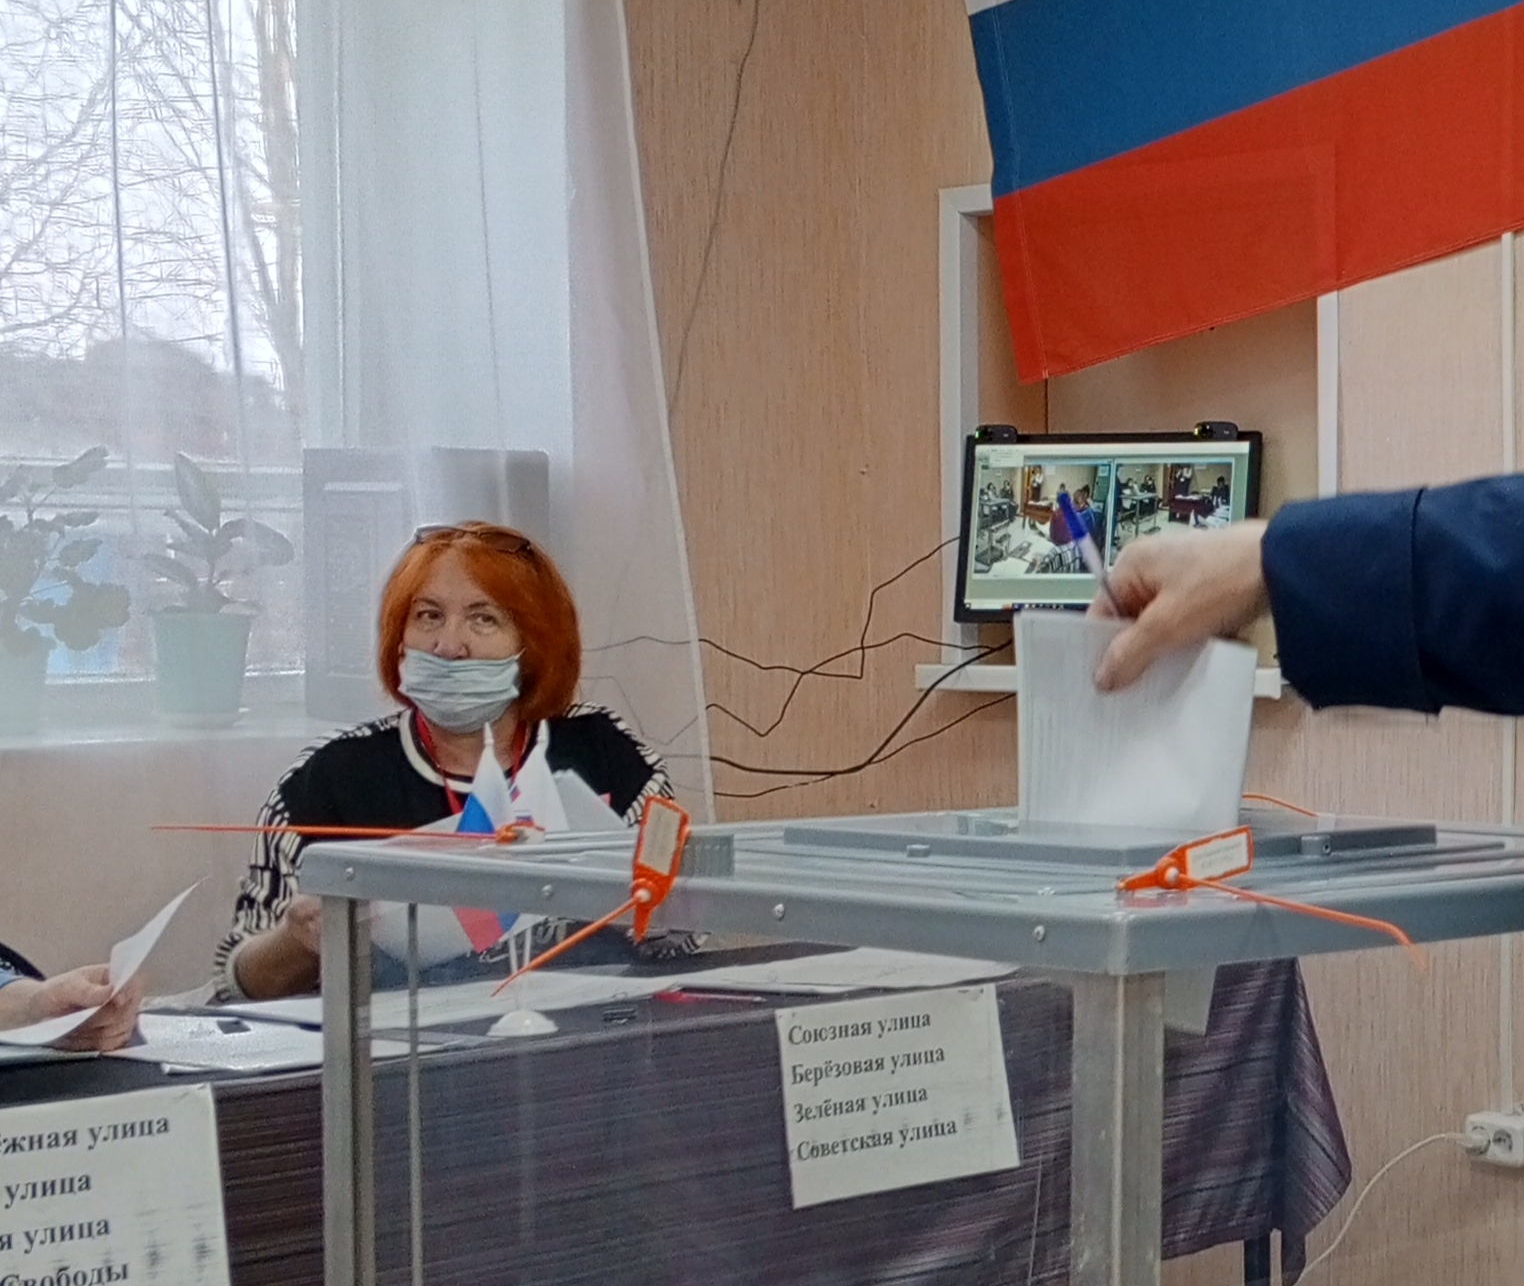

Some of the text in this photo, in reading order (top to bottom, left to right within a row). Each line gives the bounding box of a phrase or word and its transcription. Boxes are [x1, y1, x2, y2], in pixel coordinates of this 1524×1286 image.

[788, 1013, 931, 1045] Союзная улица
[791, 1047, 945, 1086] Берёзовая улица
[794, 1087, 928, 1123] Зелёная улица
[0, 1116, 170, 1155] жная улица
[797, 1119, 957, 1161] Советская улица
[4, 1173, 92, 1210] улица
[23, 1218, 111, 1254] улица
